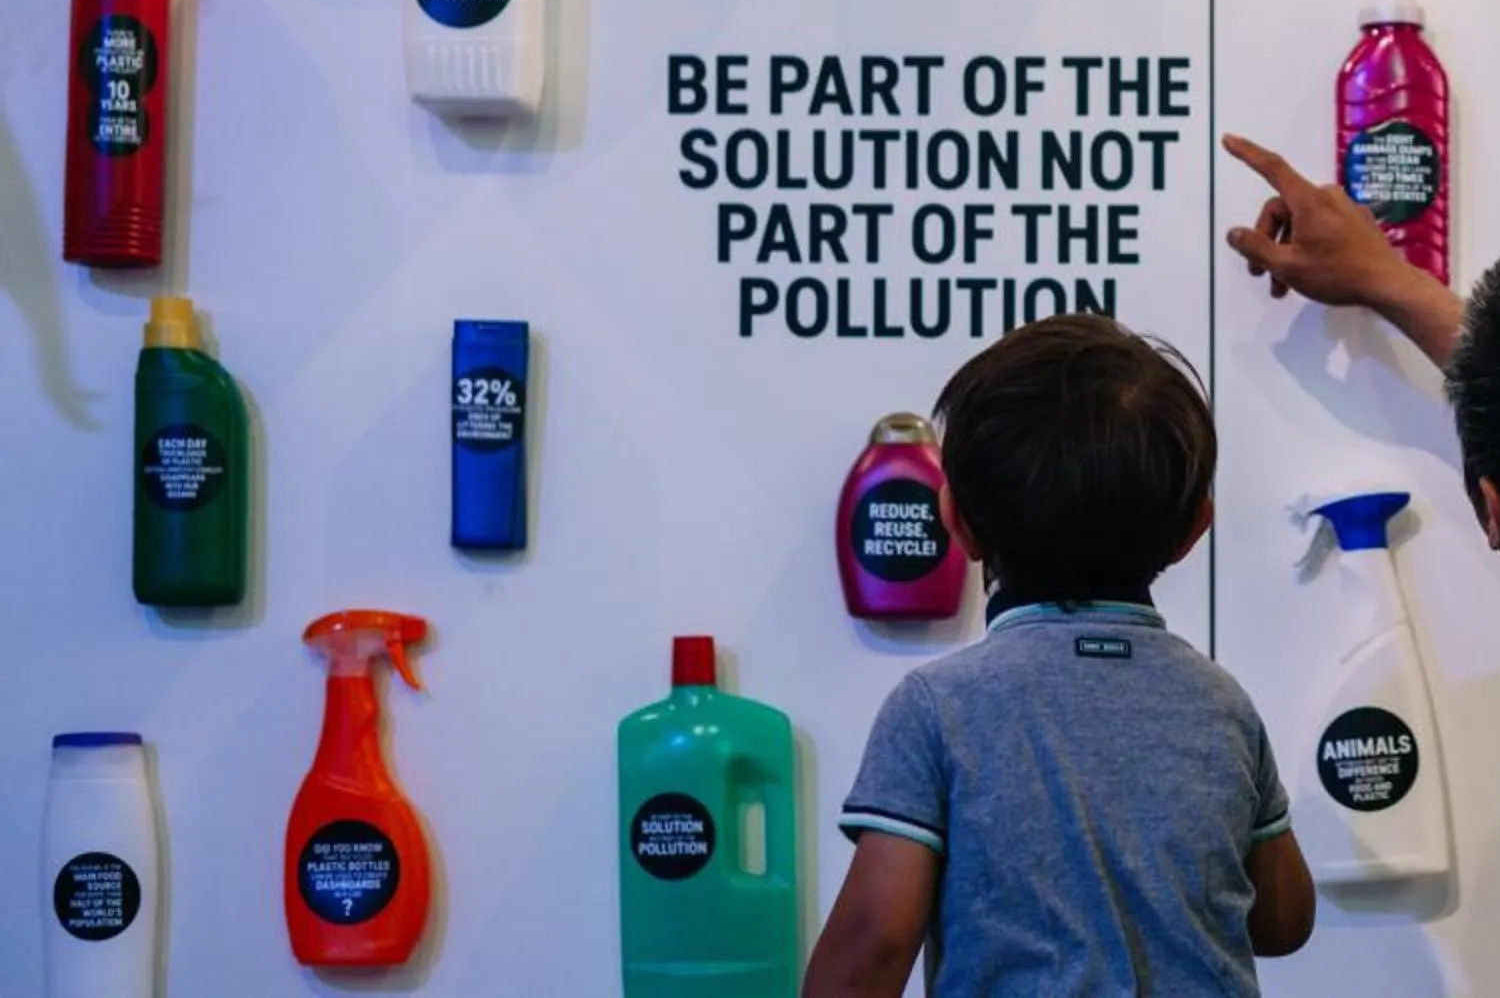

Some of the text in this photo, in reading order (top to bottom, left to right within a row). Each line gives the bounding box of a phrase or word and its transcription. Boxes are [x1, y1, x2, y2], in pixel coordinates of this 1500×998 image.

[96, 55, 144, 68] PLASTIC
[108, 80, 131, 99] 10
[668, 55, 1190, 116] BE PART OF THE
[101, 99, 137, 112] YEARS
[100, 124, 139, 137] ENTIRE
[679, 128, 1179, 191] SOLUTION NOT
[718, 203, 1139, 264] PART OF THE
[739, 277, 1117, 338] POLLUTION
[457, 378, 517, 406] 32%
[158, 438, 208, 449] EACH DAY
[869, 502, 935, 521] REDUCE,
[874, 521, 928, 539] REUSE,
[864, 539, 938, 557] RECYCLE!
[1323, 736, 1412, 761] ANIMALS
[1338, 763, 1401, 779] DIFFERENCE
[642, 820, 704, 835] SOLUTION
[639, 841, 708, 855] POLLUTION
[307, 860, 391, 872] PLASTIC BOTTLES
[98, 872, 122, 882] FOOD
[68, 918, 123, 928] POPULATION
